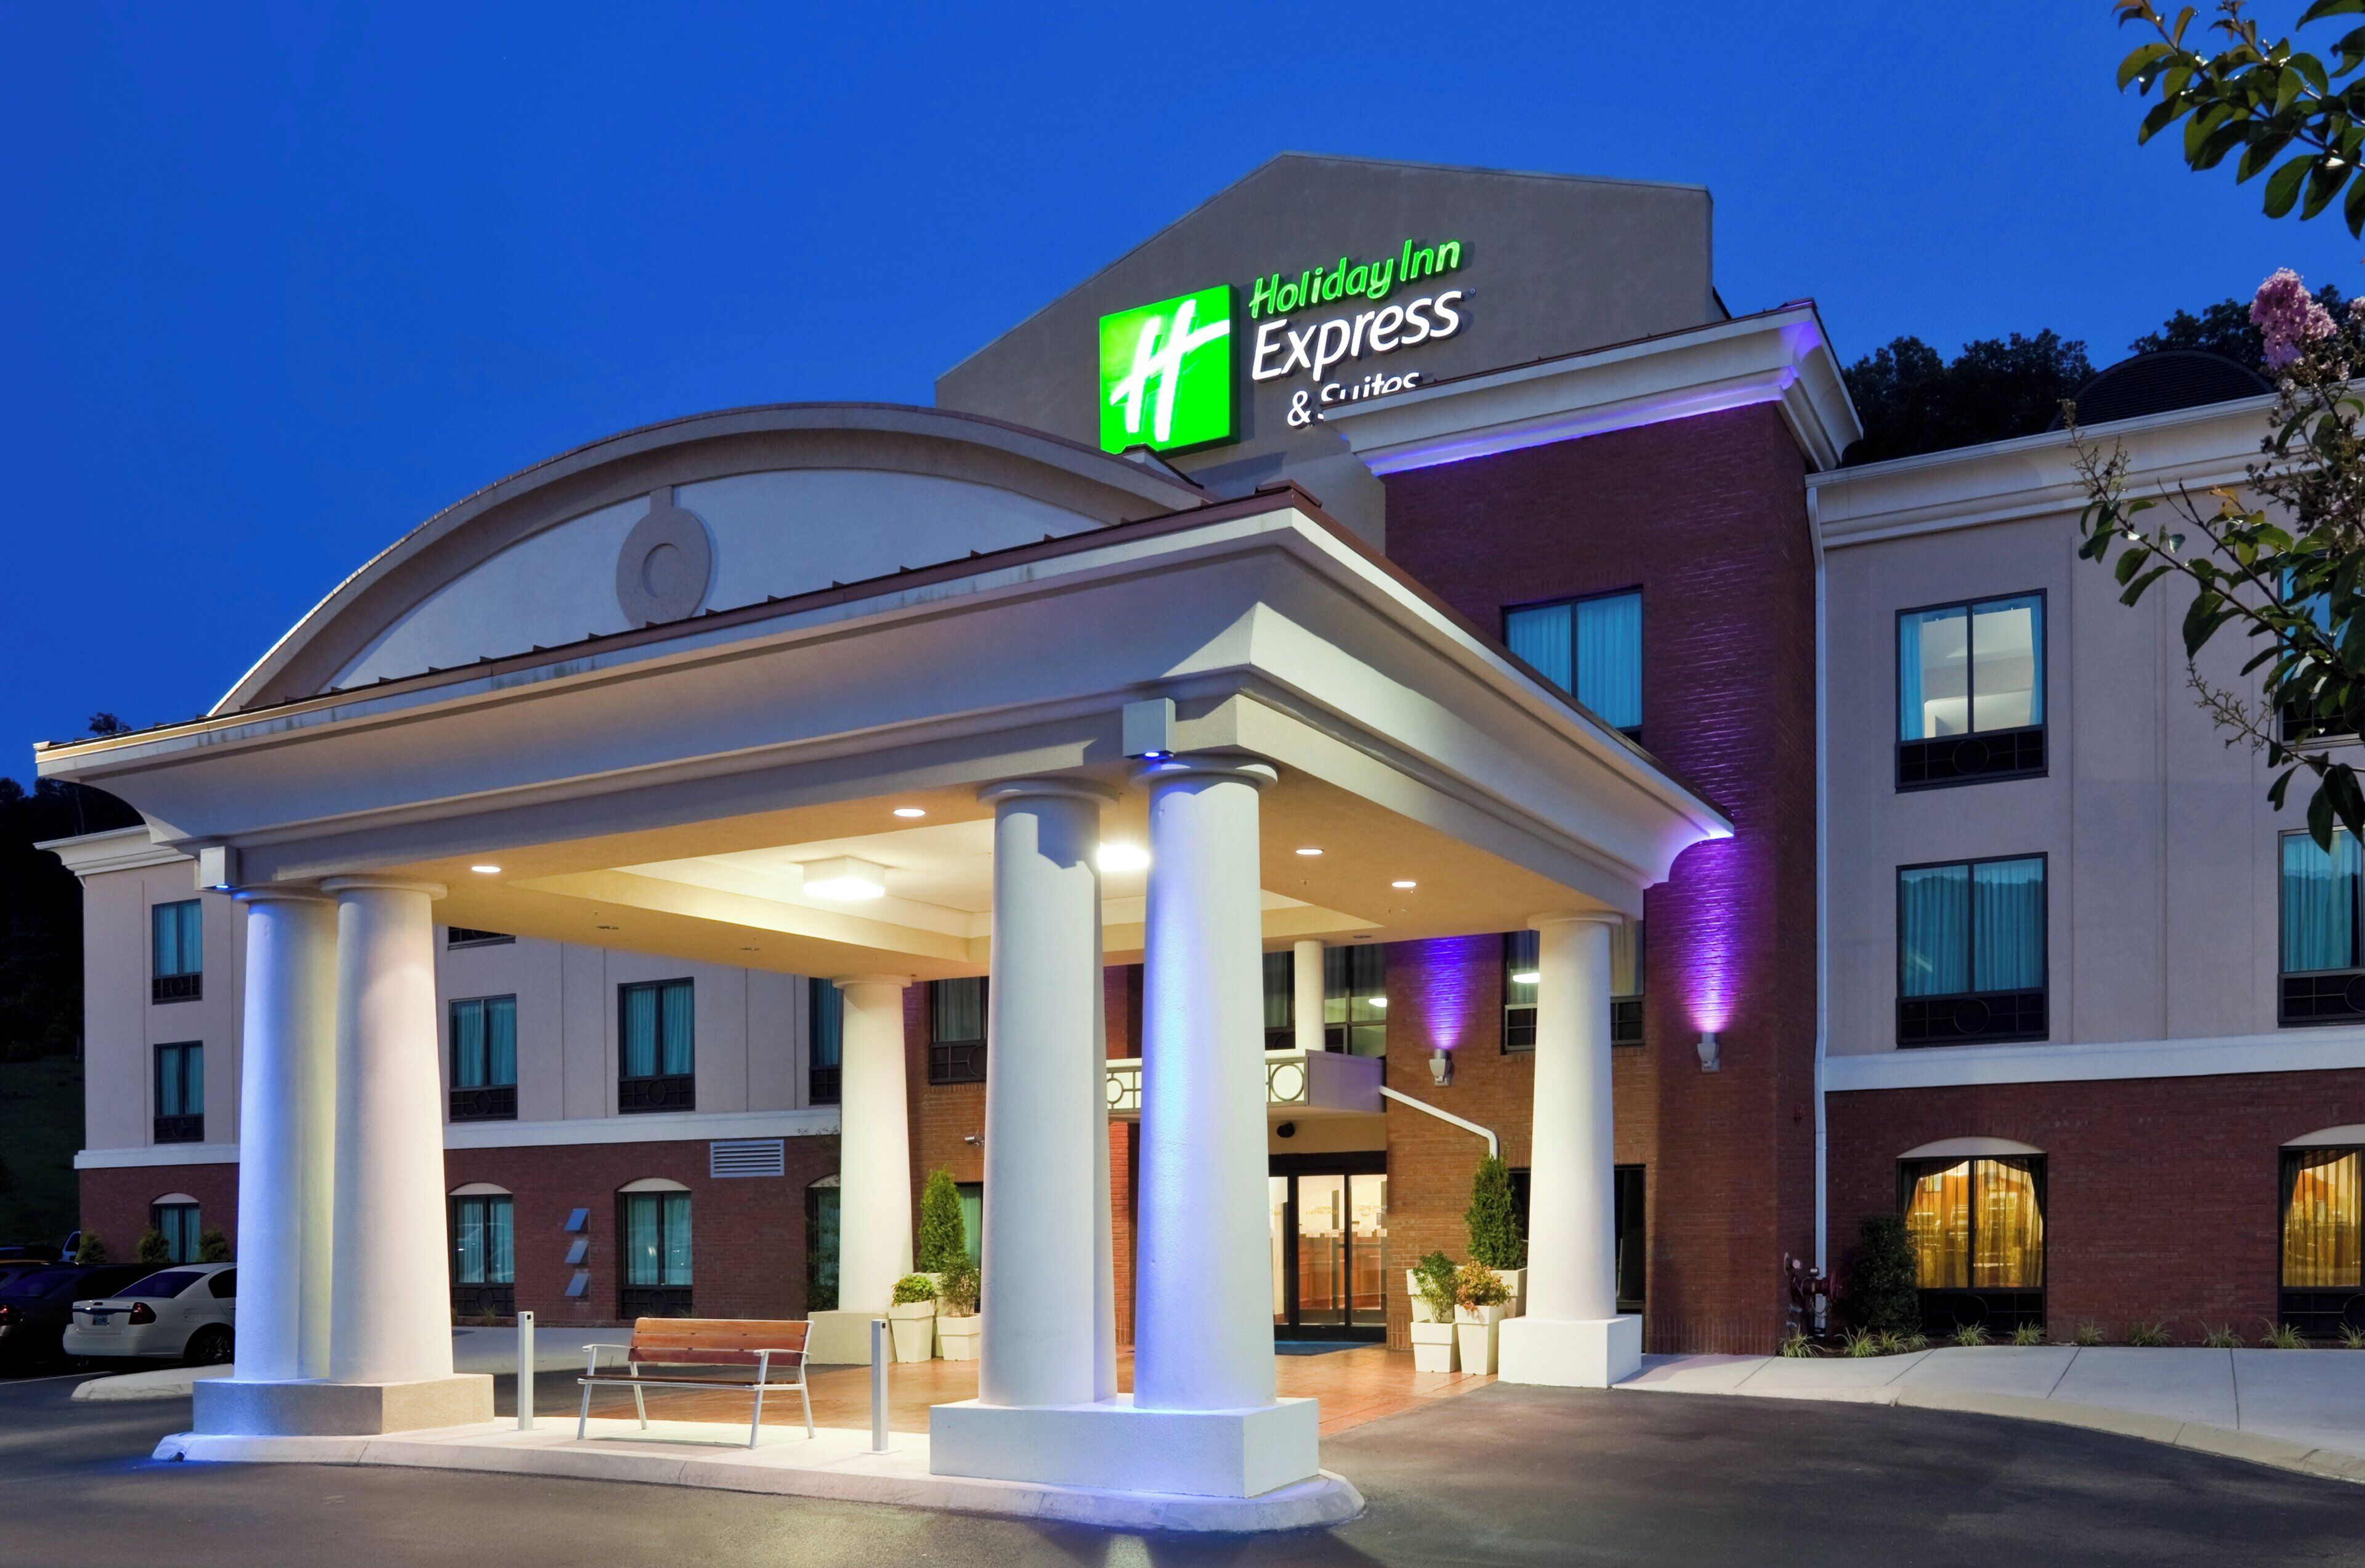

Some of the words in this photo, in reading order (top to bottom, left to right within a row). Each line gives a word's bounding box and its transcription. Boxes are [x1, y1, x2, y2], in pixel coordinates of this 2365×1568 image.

[1248, 256, 1394, 319] Holiday
[1399, 239, 1460, 282] Inn
[1251, 290, 1462, 382] Express
[1287, 390, 1311, 426] &
